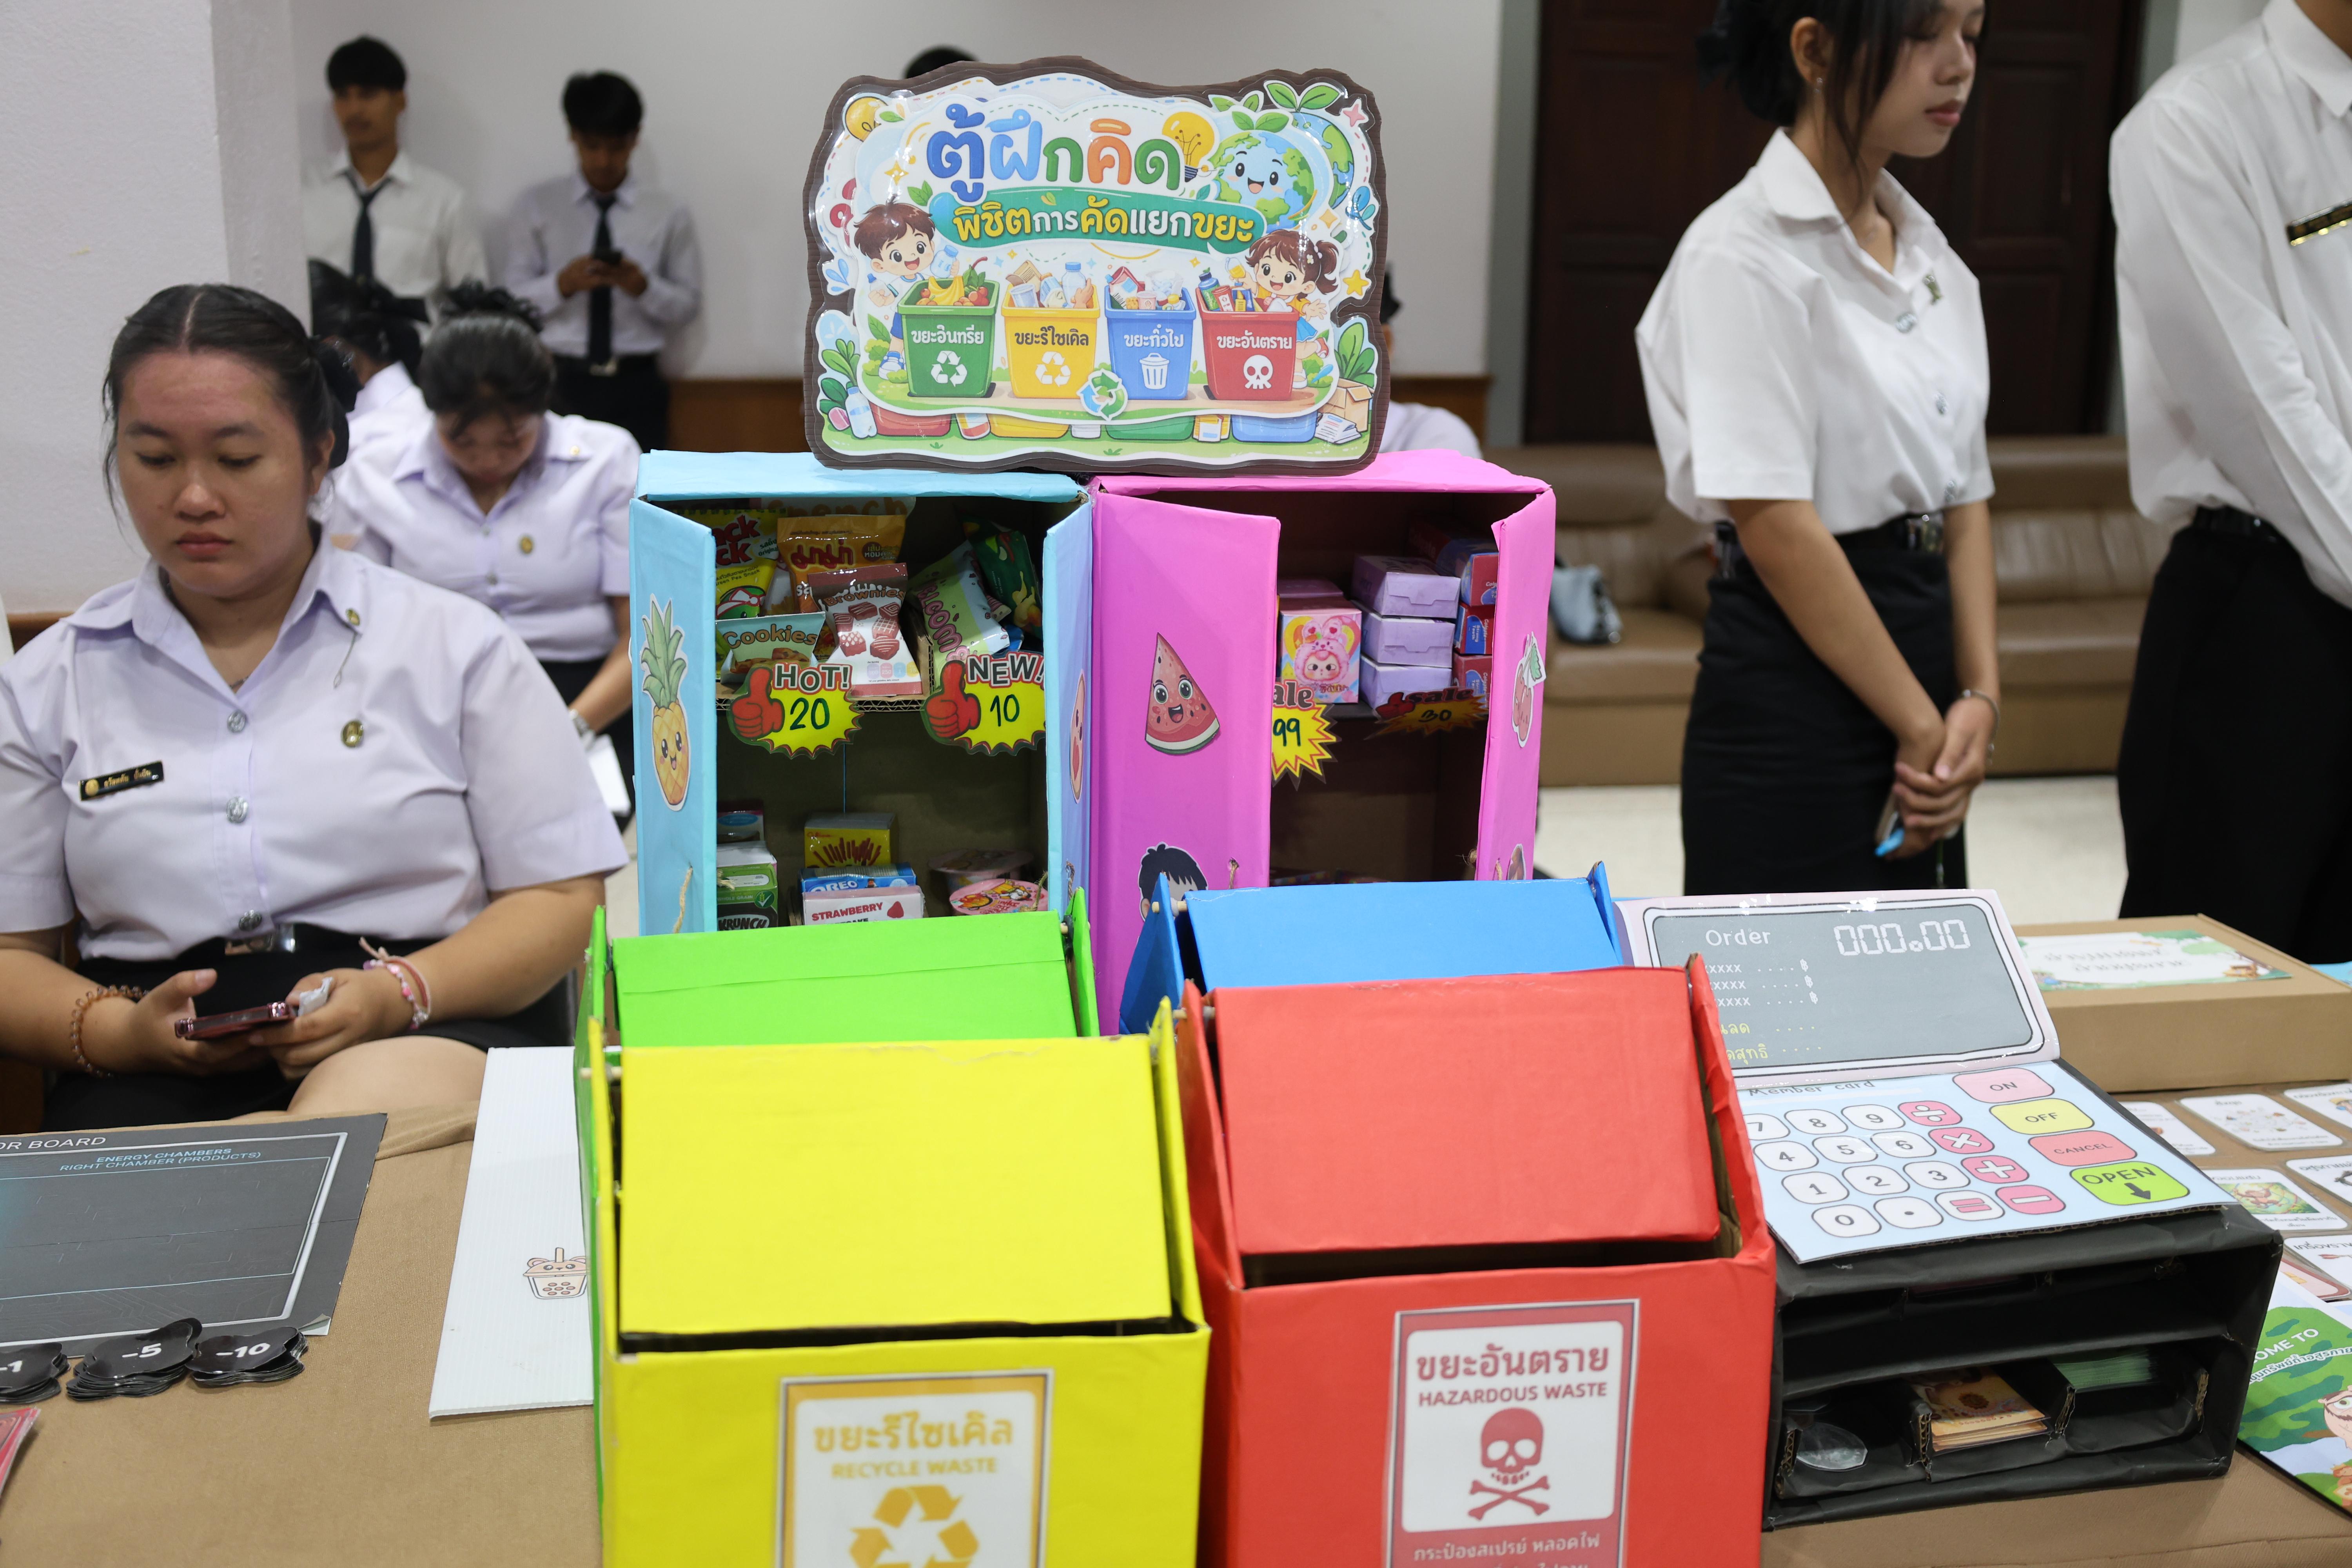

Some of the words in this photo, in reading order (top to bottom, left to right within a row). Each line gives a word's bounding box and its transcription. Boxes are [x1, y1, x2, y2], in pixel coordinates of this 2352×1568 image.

[927, 103, 1180, 202] ตู้ฝึกคิด
[824, 587, 906, 607] Brownies
[723, 624, 818, 649] Cookies
[775, 663, 849, 693] HOT!
[1273, 682, 1313, 708] ale
[789, 697, 830, 730] 20
[989, 694, 1020, 727] 10
[812, 902, 883, 921] STRAWBERRY
[718, 918, 768, 931] KRUNCH
[1705, 929, 1771, 947] Order
[1833, 919, 1971, 956] 000.00
[1749, 1087, 1822, 1096] Member
[1835, 1081, 1876, 1090] card
[1990, 1081, 2017, 1093] ON
[1810, 1117, 1828, 1128] 8
[1865, 1114, 1883, 1123] 9
[2026, 1112, 2058, 1123] OFF
[27, 1137, 106, 1149] BOARD
[1778, 1151, 1795, 1163] 4
[1837, 1144, 1855, 1155] 5
[1895, 1140, 1913, 1151] 6
[2054, 1143, 2112, 1155] CANCEL
[60, 1163, 102, 1171] RIGHT
[105, 1158, 174, 1168] CHAMBER
[178, 1152, 262, 1164] (PRODUCTS)
[96, 1153, 151, 1163] ENERGY
[154, 1149, 232, 1158] CHAMBERS
[1810, 1183, 1825, 1196] 1
[1866, 1175, 1890, 1188] 2
[1929, 1170, 1947, 1181] 3
[2082, 1166, 2156, 1185] OPEN
[2290, 1328, 2319, 1342] TO
[122, 1343, 162, 1358] -5
[216, 1343, 271, 1358] -10
[1416, 1343, 1609, 1381] ขยะอันตราย
[1419, 1386, 1538, 1407] HAZARDOUS
[1544, 1382, 1608, 1399] WASTE
[813, 1410, 1013, 1453] ขยะรีไซเคิล
[831, 1460, 920, 1479] RECYCLE
[928, 1457, 997, 1475] WASTE
[1413, 1537, 1527, 1561] กระป๋องสเปรย์
[1532, 1531, 1600, 1553] หลอดไฟ
